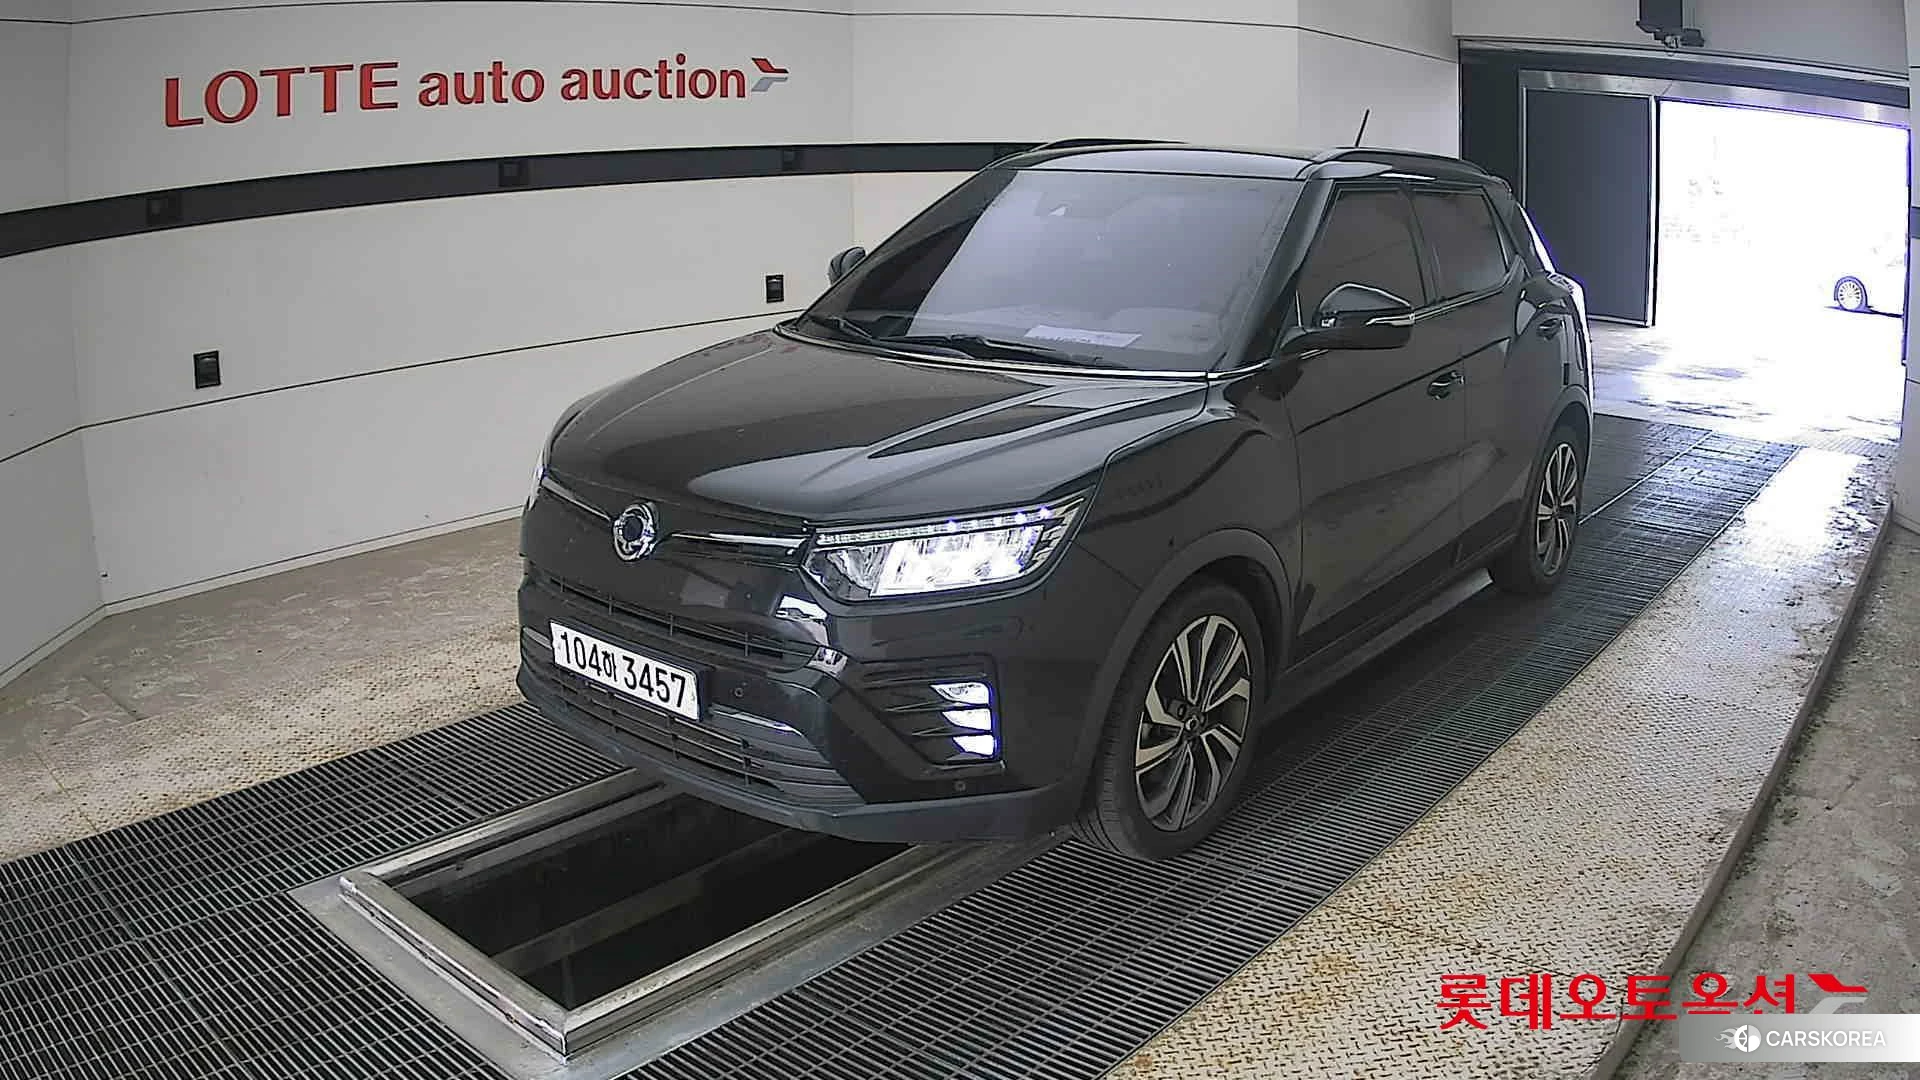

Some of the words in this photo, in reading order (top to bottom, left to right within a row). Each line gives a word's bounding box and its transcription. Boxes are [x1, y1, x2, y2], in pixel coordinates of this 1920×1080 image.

[164, 61, 399, 128] LOTTE
[417, 60, 545, 107] auto
[560, 52, 747, 101] auction
[622, 655, 686, 708] 3457
